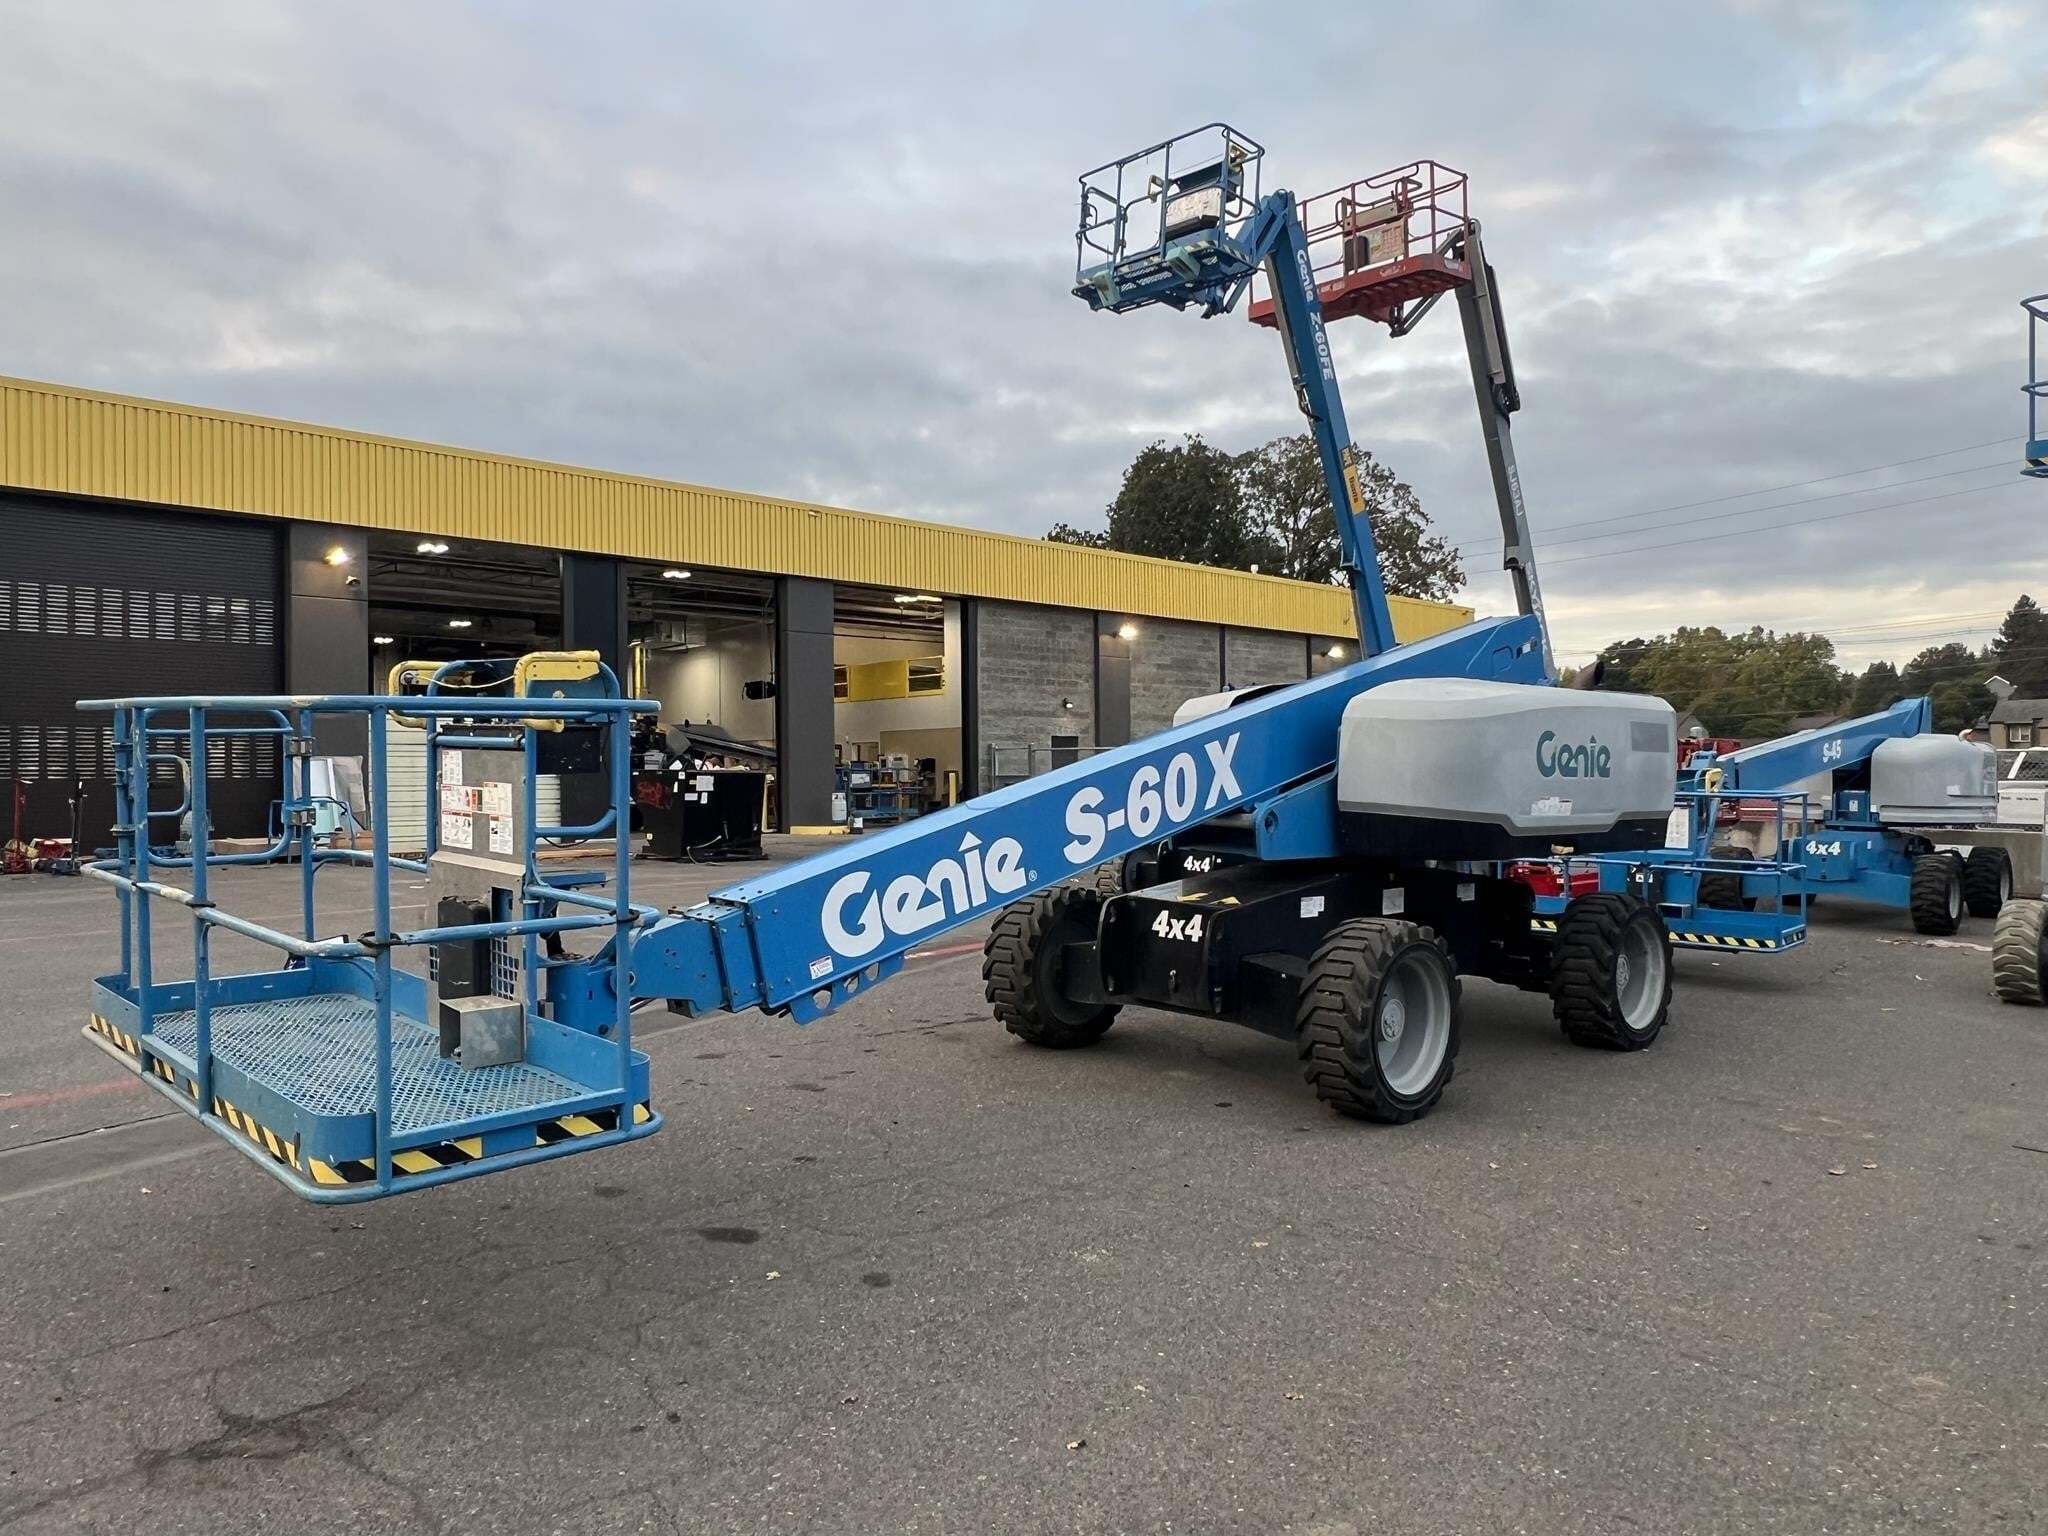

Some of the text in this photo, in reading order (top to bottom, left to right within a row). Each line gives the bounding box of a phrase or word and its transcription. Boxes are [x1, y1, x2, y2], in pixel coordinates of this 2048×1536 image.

[1297, 249, 1314, 302] Genie
[1536, 730, 1611, 778] Genie
[1822, 739, 1842, 763] S-45
[1183, 855, 1210, 873] 4x4
[1805, 840, 1841, 856] 4x4
[821, 831, 1027, 958] Genie
[1151, 909, 1203, 943] 4x4
